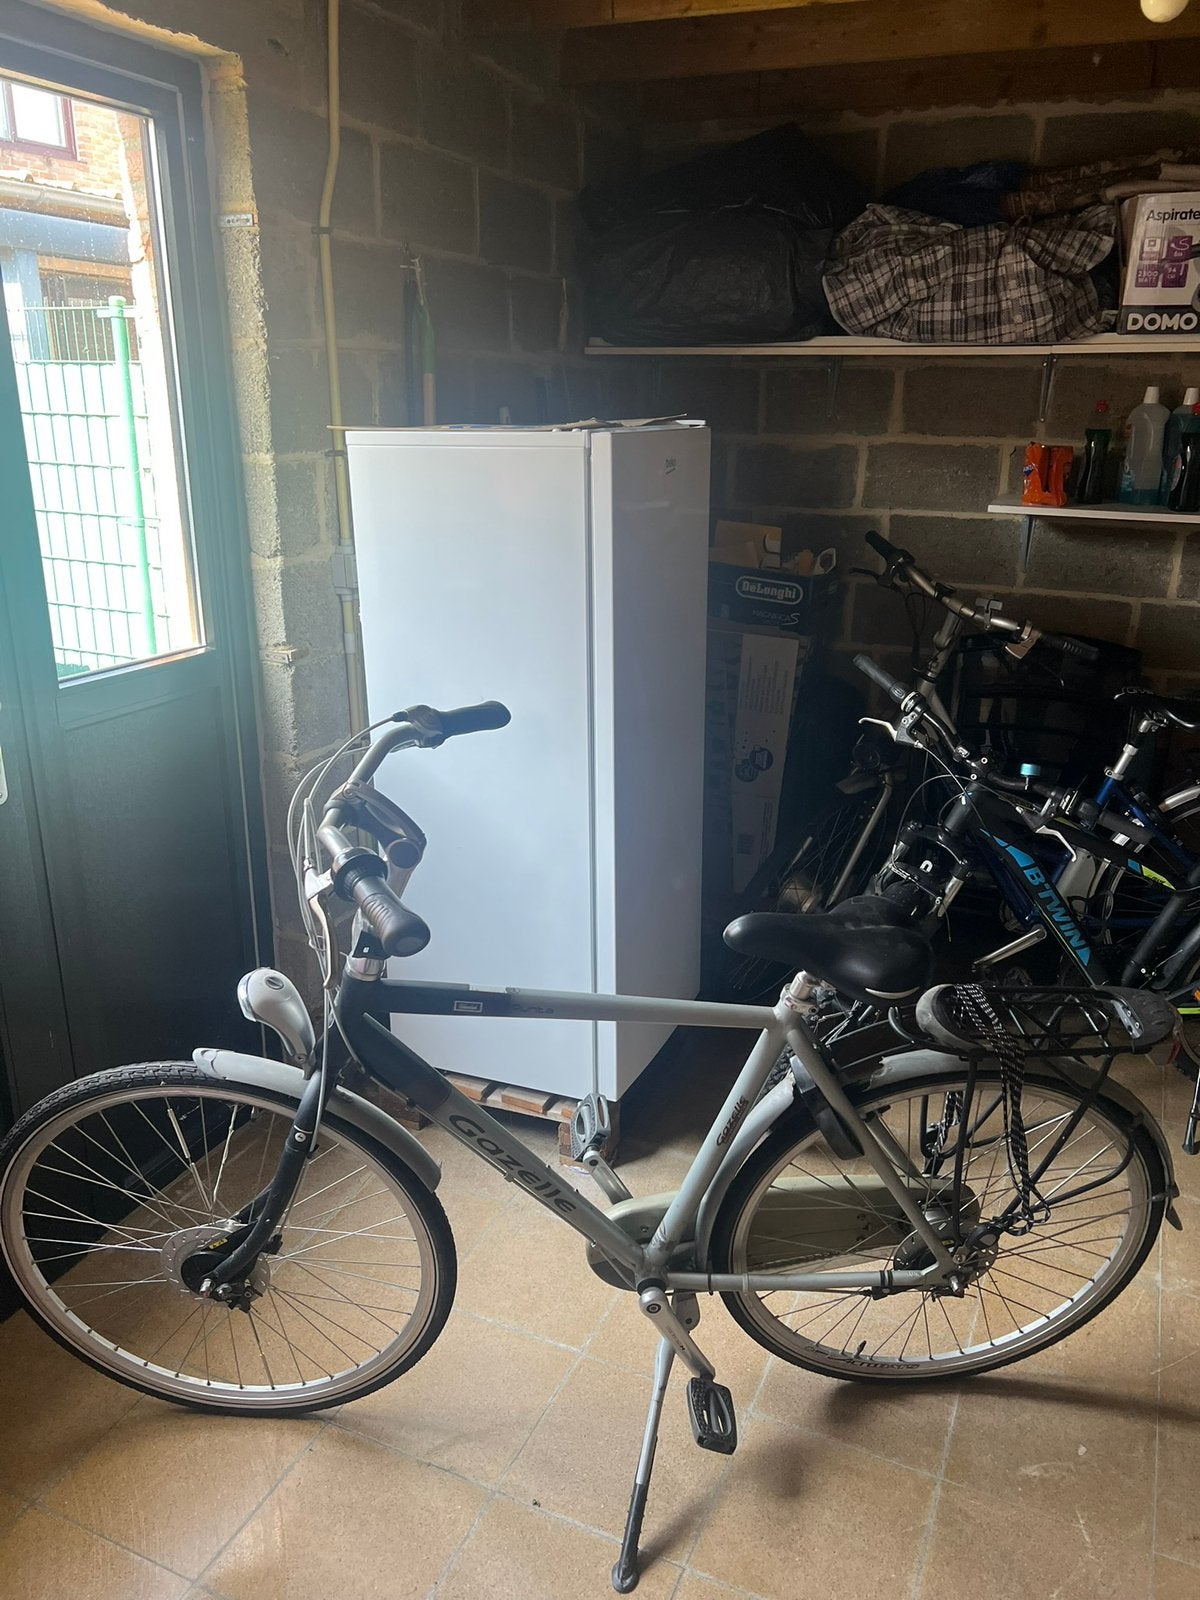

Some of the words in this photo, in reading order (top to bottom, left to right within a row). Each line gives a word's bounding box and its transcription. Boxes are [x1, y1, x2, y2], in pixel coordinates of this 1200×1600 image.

[1127, 313, 1198, 331] DOMO
[742, 580, 797, 600] DeLonghi
[716, 1095, 747, 1146] Gazelle
[449, 1114, 577, 1213] Gazelle
